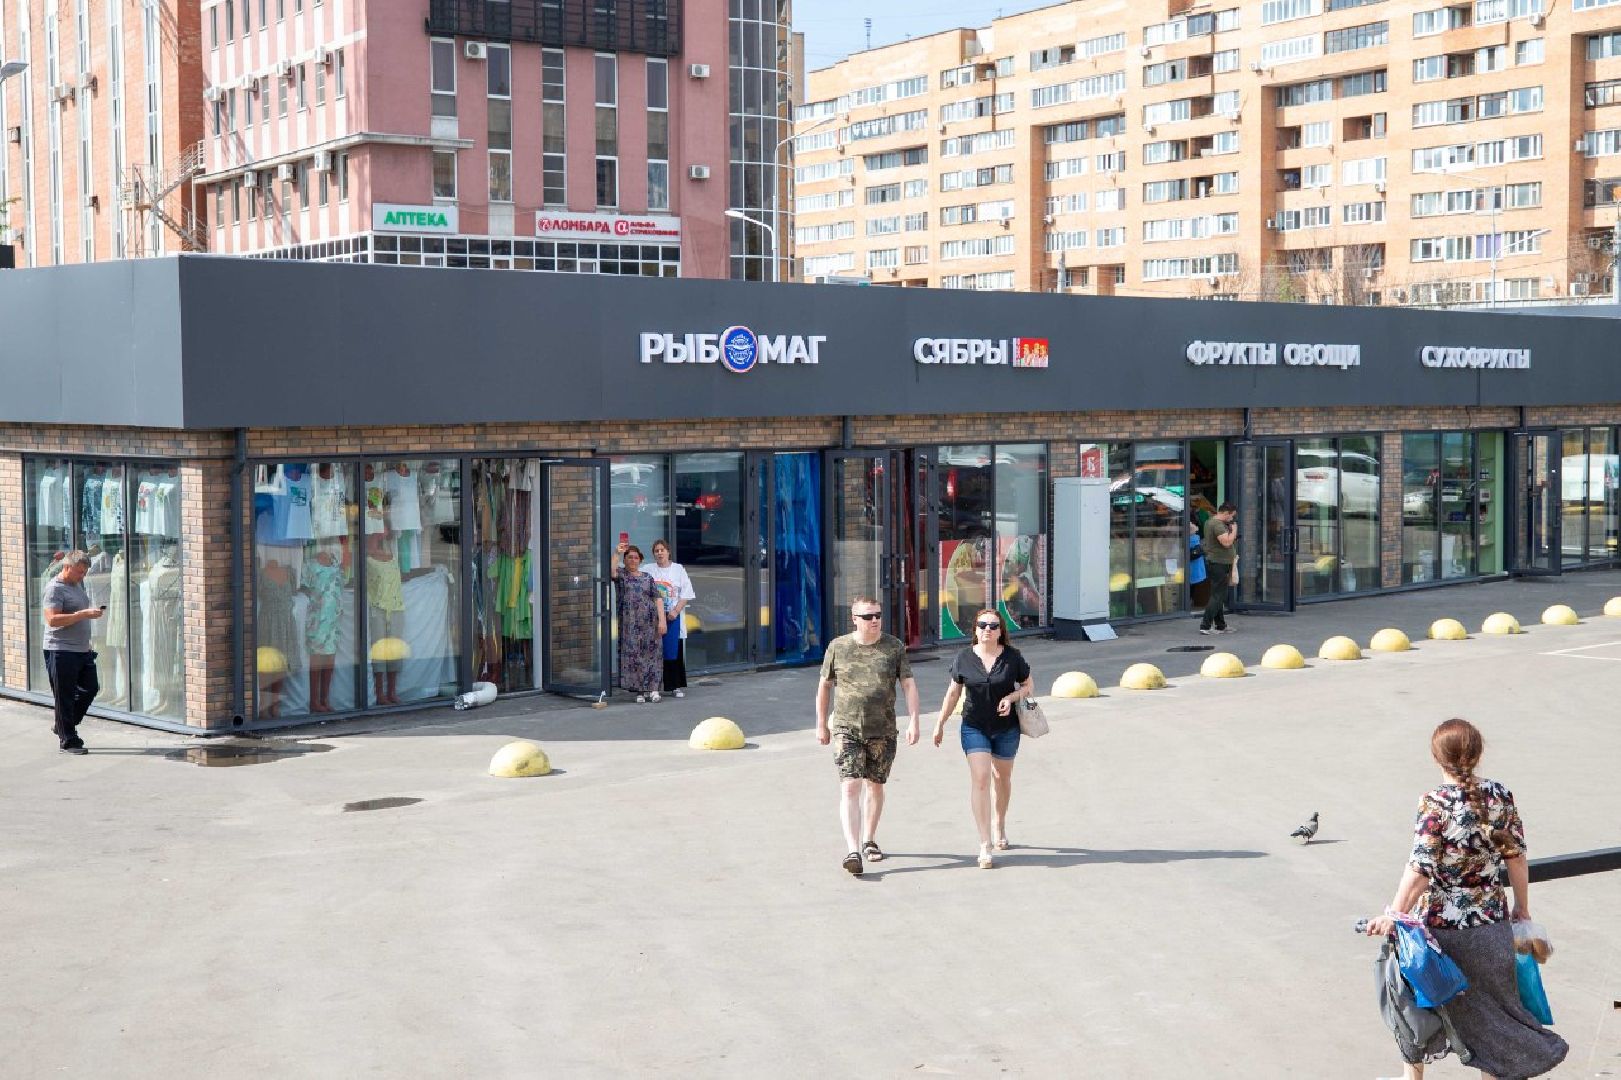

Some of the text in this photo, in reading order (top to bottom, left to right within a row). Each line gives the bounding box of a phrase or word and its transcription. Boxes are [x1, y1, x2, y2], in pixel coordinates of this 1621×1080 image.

[384, 211, 448, 227] АПТЕКА
[552, 219, 611, 233] ЛОМБАРД
[914, 337, 1008, 364] СЯБРЫ
[1186, 340, 1361, 370] ФРУКТЫ ОВОЩИ
[1421, 345, 1531, 369] СУХОФРУКТЫ
